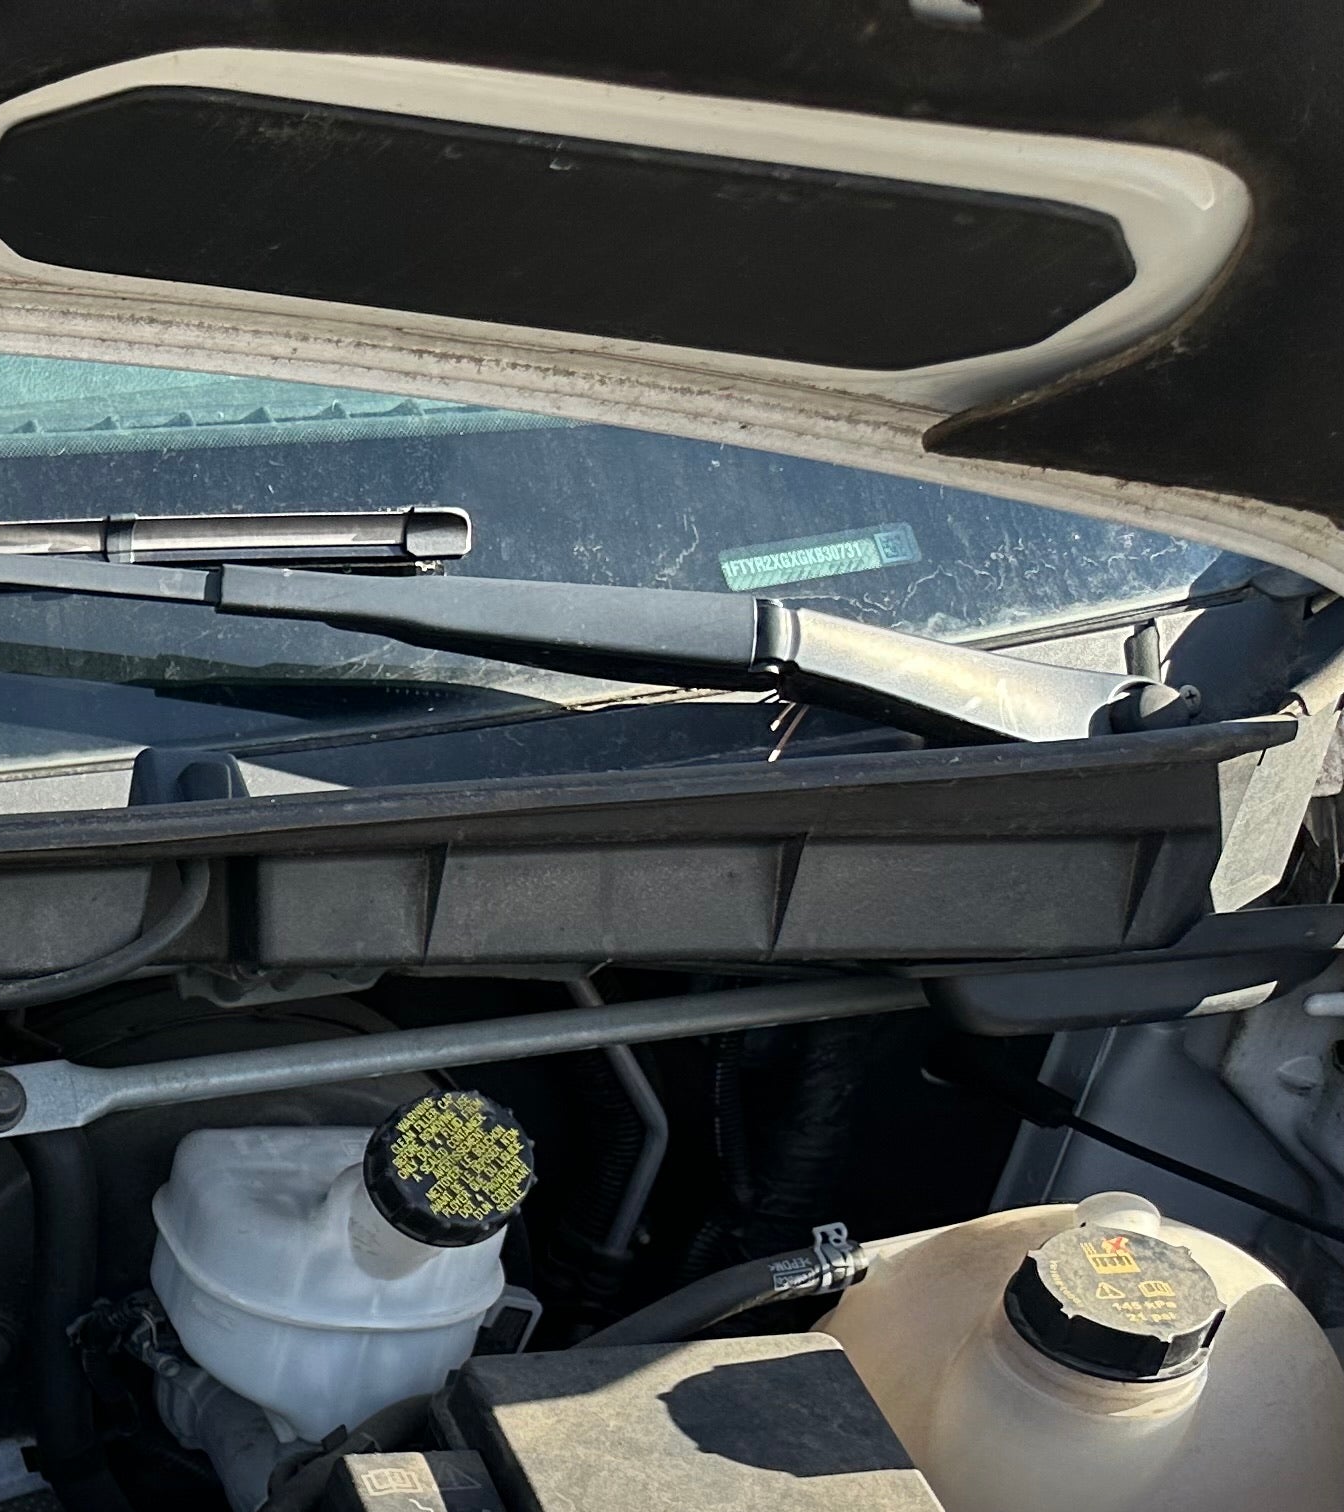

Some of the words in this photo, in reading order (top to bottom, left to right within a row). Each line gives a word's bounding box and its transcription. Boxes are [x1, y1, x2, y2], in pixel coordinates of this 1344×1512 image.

[390, 1130, 416, 1154] CLEAN
[413, 1108, 439, 1132] FILLER
[437, 1093, 454, 1109] CAP
[392, 1141, 421, 1168] BEFORE
[397, 1160, 418, 1179] ONLY
[416, 1144, 434, 1161] DOT
[433, 1136, 442, 1145] 4
[412, 1171, 421, 1182] A
[419, 1147, 448, 1174] SEALED
[425, 1166, 462, 1200] NETTOYER
[460, 1156, 473, 1167] LE
[450, 1181, 463, 1193] DE
[461, 1171, 473, 1183] LE
[469, 1176, 486, 1191] QUE
[484, 1164, 498, 1177] DU
[458, 1202, 476, 1218] DOT
